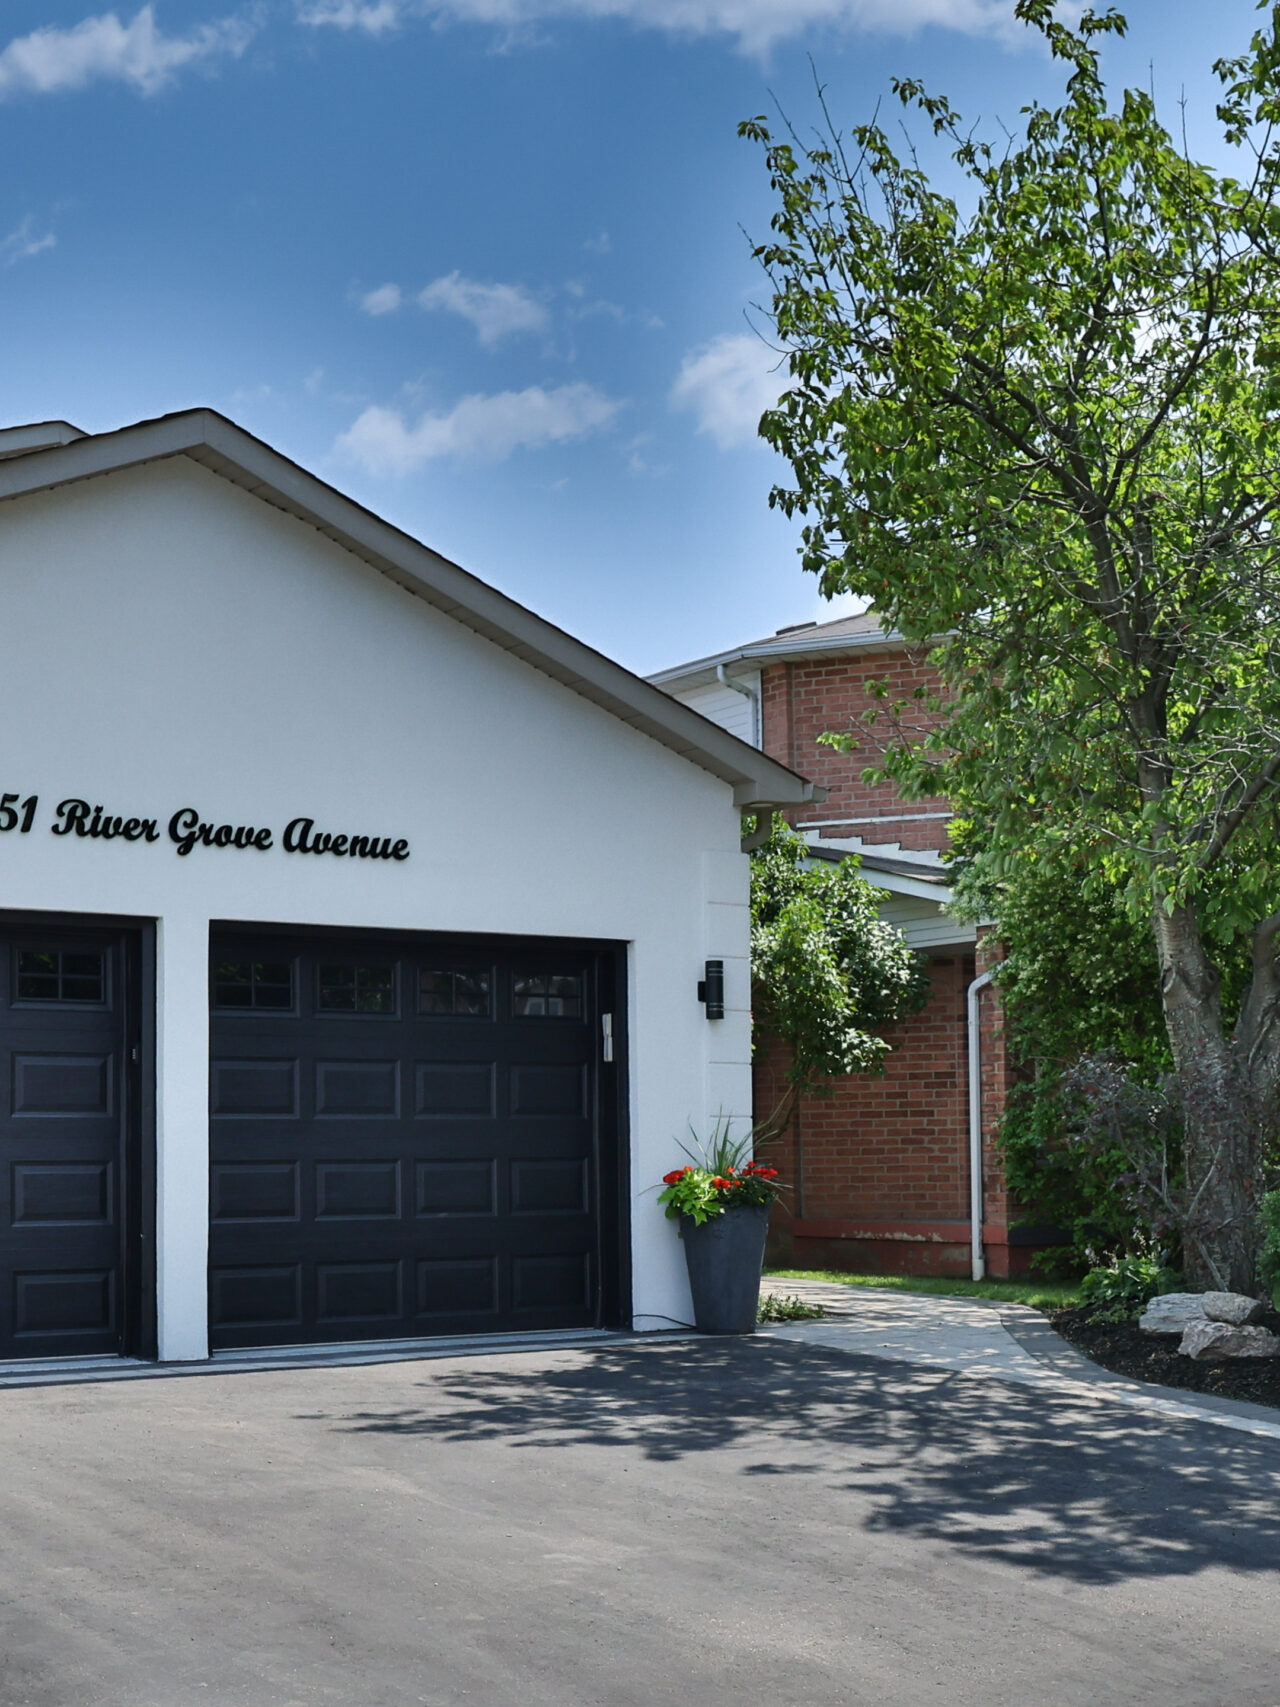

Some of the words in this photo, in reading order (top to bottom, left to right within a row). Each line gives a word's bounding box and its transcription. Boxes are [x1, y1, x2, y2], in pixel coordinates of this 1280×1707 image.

[50, 798, 161, 843] River
[167, 807, 274, 857] Grove
[282, 817, 410, 862] Avenue
